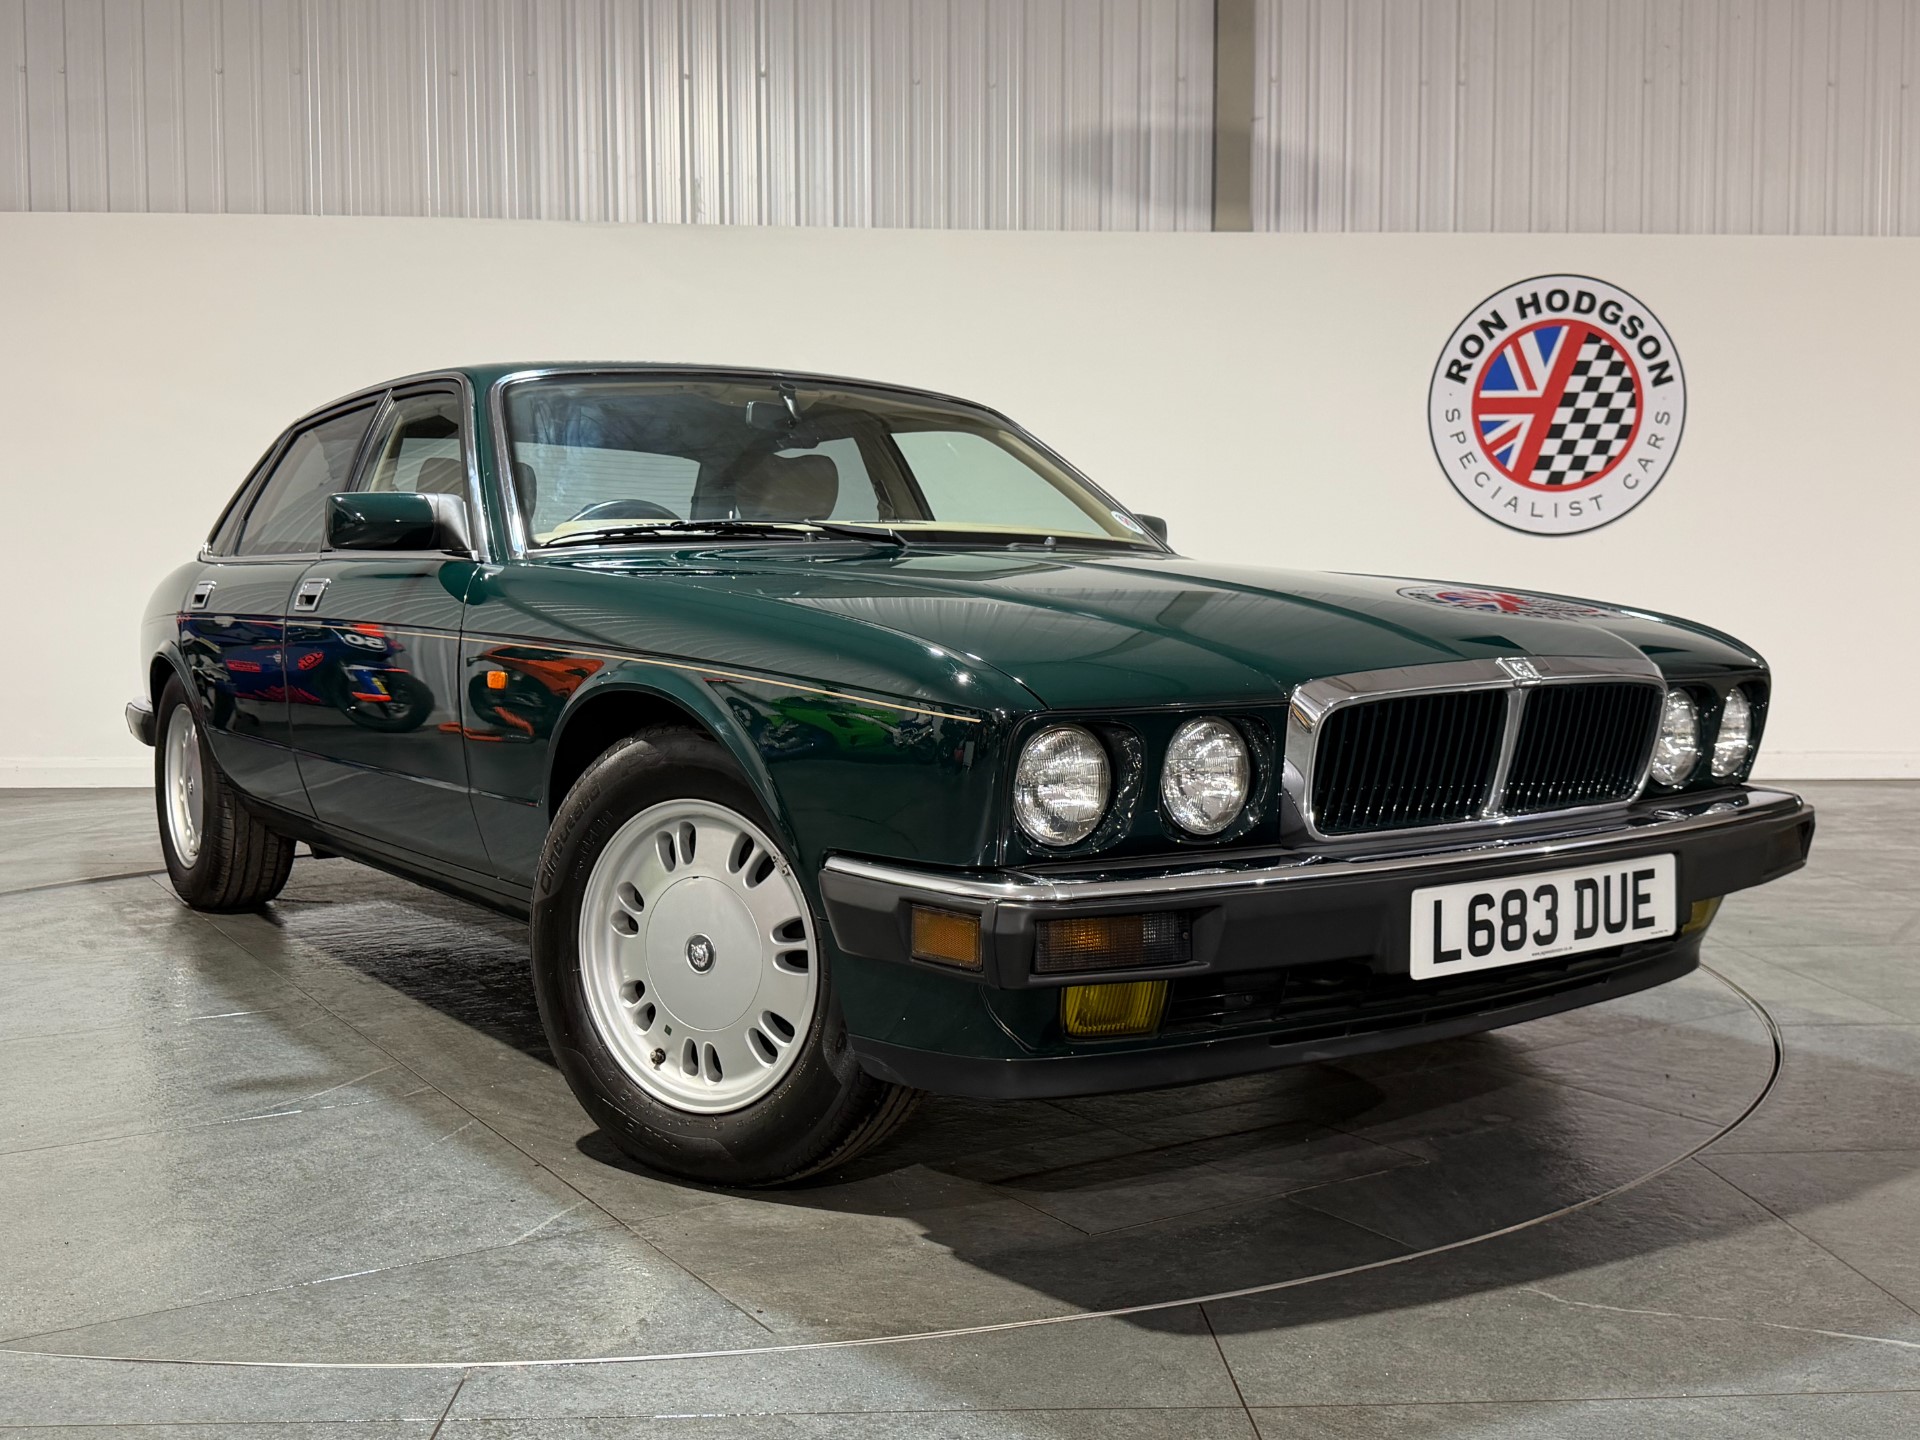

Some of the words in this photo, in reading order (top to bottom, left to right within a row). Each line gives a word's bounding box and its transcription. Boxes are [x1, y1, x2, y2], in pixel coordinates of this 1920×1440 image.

[1445, 310, 1508, 385] RON
[1515, 288, 1675, 388] HODGSON
[1445, 407, 1603, 518] SPECIALIST
[1622, 410, 1671, 491] CARS
[1433, 884, 1558, 964] L683
[1574, 868, 1655, 940] DUE
